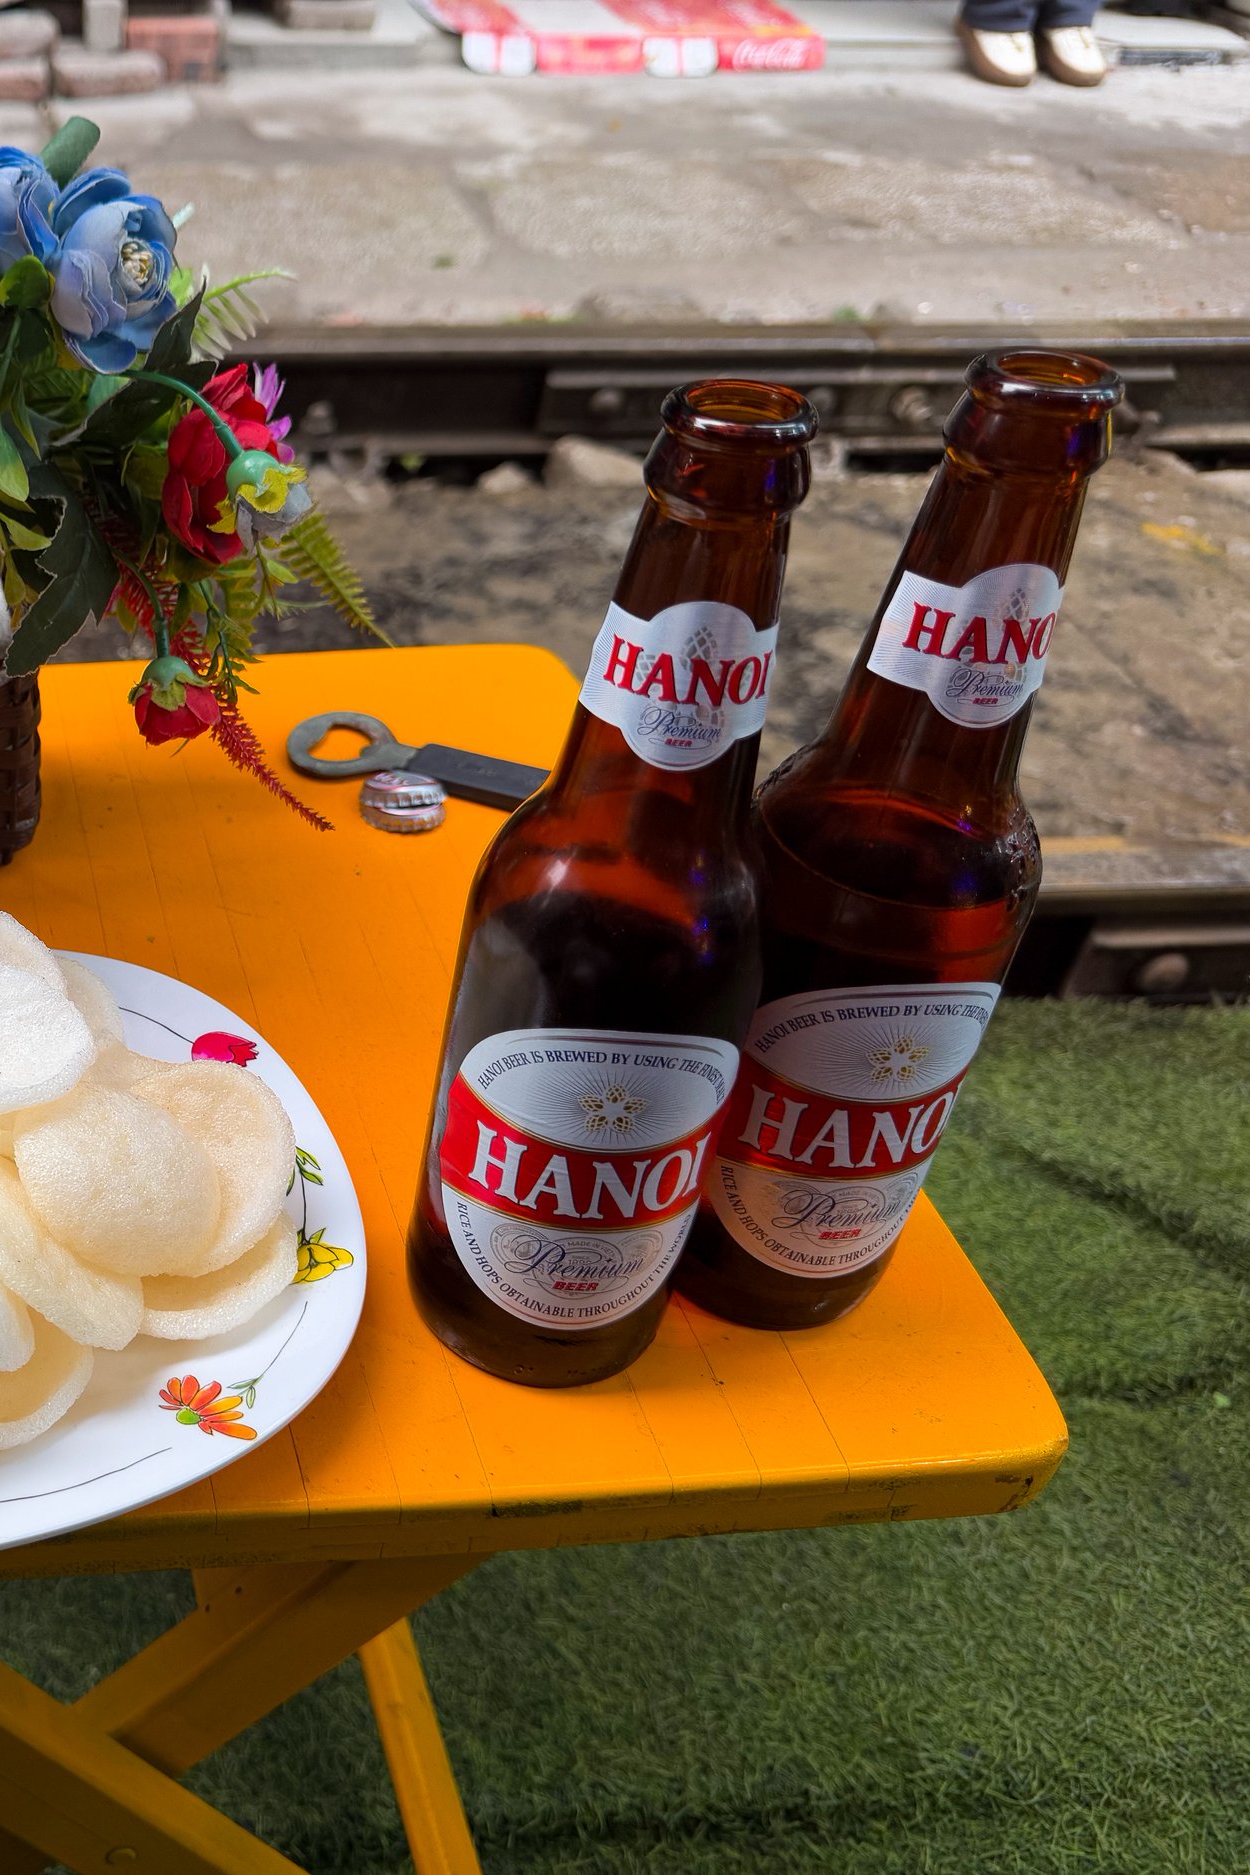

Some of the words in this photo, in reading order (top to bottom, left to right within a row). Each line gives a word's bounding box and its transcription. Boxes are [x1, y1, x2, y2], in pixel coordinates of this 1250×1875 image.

[902, 601, 1056, 664] HANO
[602, 633, 773, 707] HANOI
[946, 668, 1024, 697] Premium
[972, 697, 999, 705] BEER
[637, 706, 721, 739] Premium
[664, 738, 692, 747] BEER
[755, 1022, 790, 1053] HANOI
[786, 1013, 821, 1032] BEER
[820, 1009, 835, 1023] IS
[837, 1006, 900, 1021] BREWED
[903, 1004, 922, 1017] BY
[924, 1004, 962, 1017] USING
[478, 1060, 504, 1090] HANOI
[503, 1053, 530, 1070] BEER
[530, 1051, 544, 1064] IS
[547, 1050, 607, 1063] BREWED
[611, 1053, 630, 1065] BY
[634, 1054, 679, 1069] USING
[678, 1058, 703, 1074] THE
[737, 1081, 962, 1168] HANO
[467, 1119, 711, 1220] HANOI
[721, 1165, 737, 1191] RICE
[456, 1201, 472, 1230] RICE
[726, 1190, 747, 1216] AND
[771, 1189, 901, 1228] Premium
[463, 1229, 482, 1255] AND
[740, 1215, 768, 1241] HOPS
[818, 1228, 861, 1240] BEER
[838, 1216, 903, 1265] THROUGHOUT
[504, 1235, 643, 1279] Premium
[653, 1254, 671, 1274] THE
[764, 1238, 836, 1266] OBTAINABLE
[475, 1256, 503, 1285] HOPS
[499, 1282, 574, 1318] OBTAINABLE
[551, 1280, 599, 1292] BEER
[577, 1272, 655, 1318] THROUGHOUT
